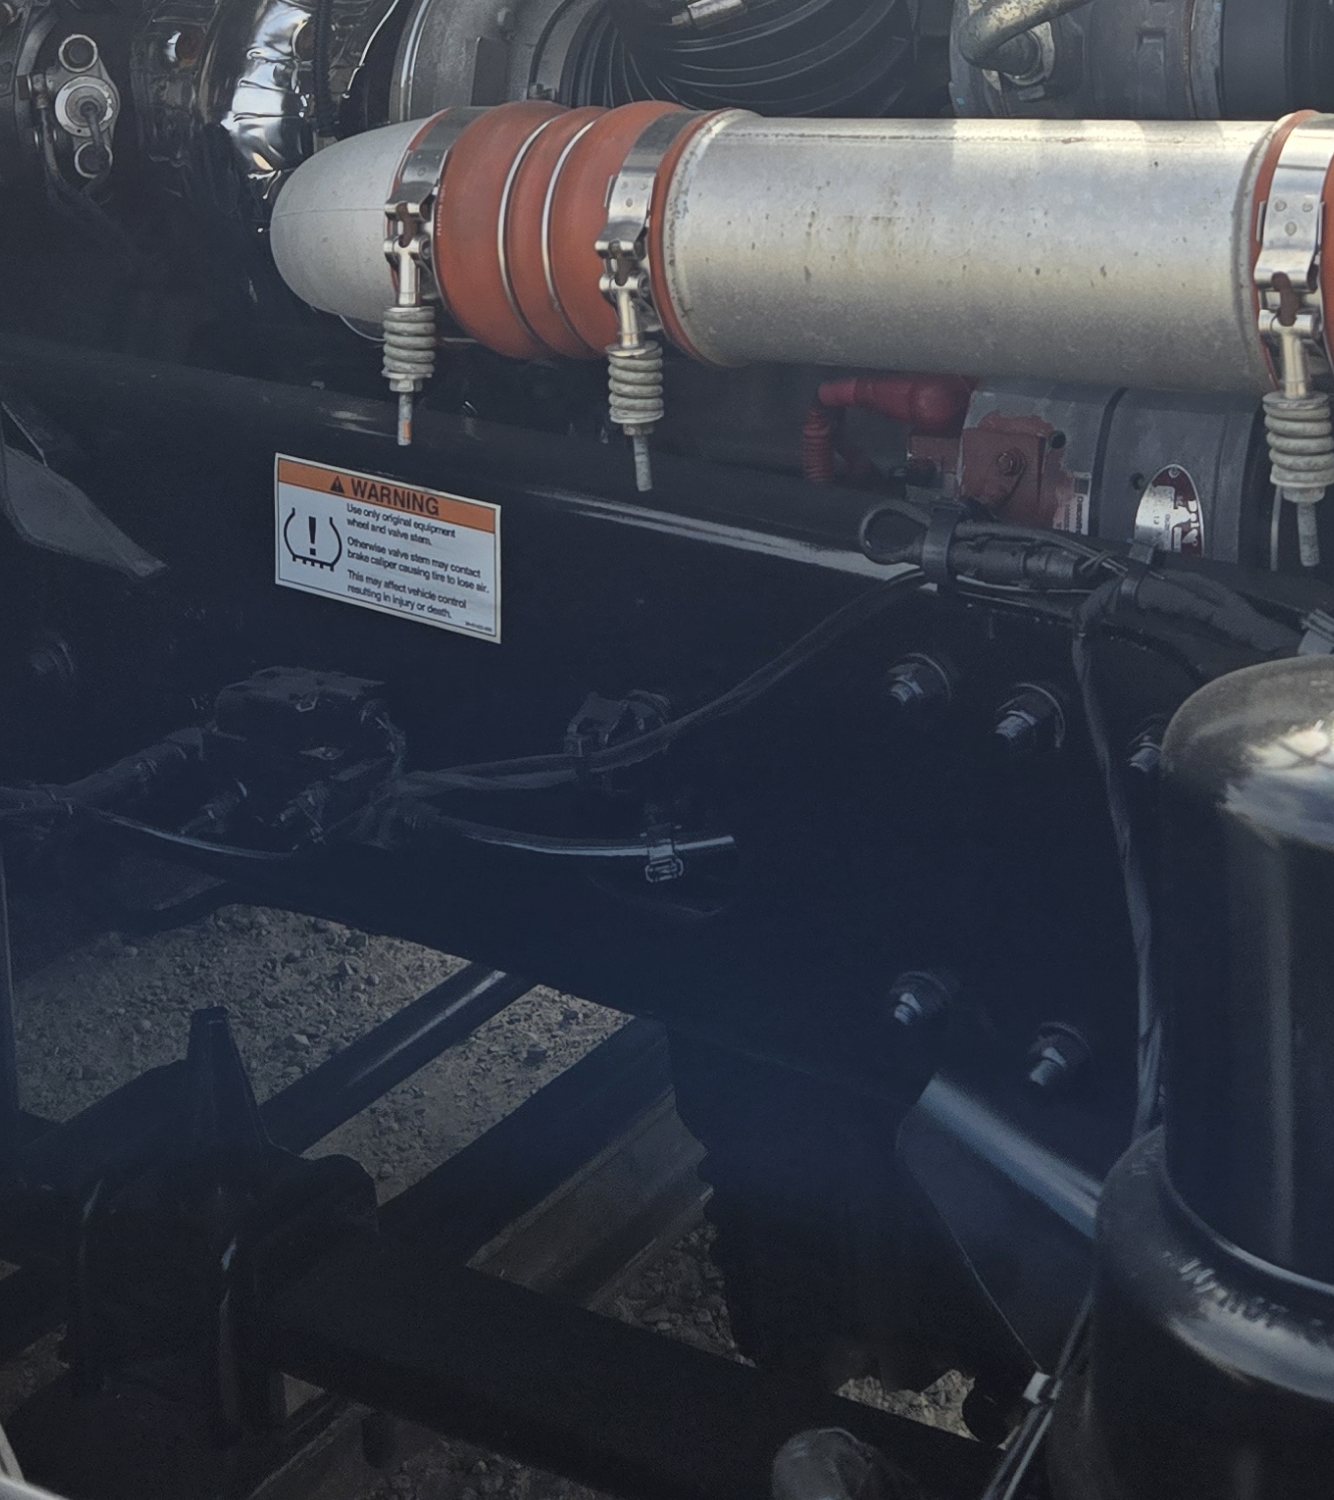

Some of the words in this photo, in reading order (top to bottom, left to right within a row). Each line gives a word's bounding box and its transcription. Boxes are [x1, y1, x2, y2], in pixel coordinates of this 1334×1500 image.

[351, 477, 440, 516] WARNING
[347, 503, 362, 515] Use
[364, 508, 380, 521] only
[382, 512, 412, 528] original
[413, 521, 456, 538] equipment
[347, 517, 369, 529] wheel
[371, 523, 385, 534] and
[388, 528, 409, 540] valve
[410, 533, 432, 545] stem.
[348, 536, 386, 554] Otherwise
[388, 548, 409, 560] valve
[411, 553, 430, 565] stem
[432, 559, 449, 571] may
[450, 564, 480, 578] contact
[348, 549, 369, 563] brake
[371, 554, 397, 570] caliper
[399, 564, 430, 580] causing
[432, 570, 445, 582] tire
[447, 575, 455, 585] to
[457, 577, 474, 590] lose
[476, 583, 489, 593] air.
[348, 569, 364, 582] This
[366, 575, 382, 588] may
[384, 579, 406, 593] affect
[408, 585, 436, 600] vehicle
[438, 595, 466, 609] control
[348, 585, 381, 601] resulting
[384, 593, 391, 602] in
[393, 594, 415, 610] injury
[416, 603, 425, 611] or
[427, 605, 452, 618] death.
